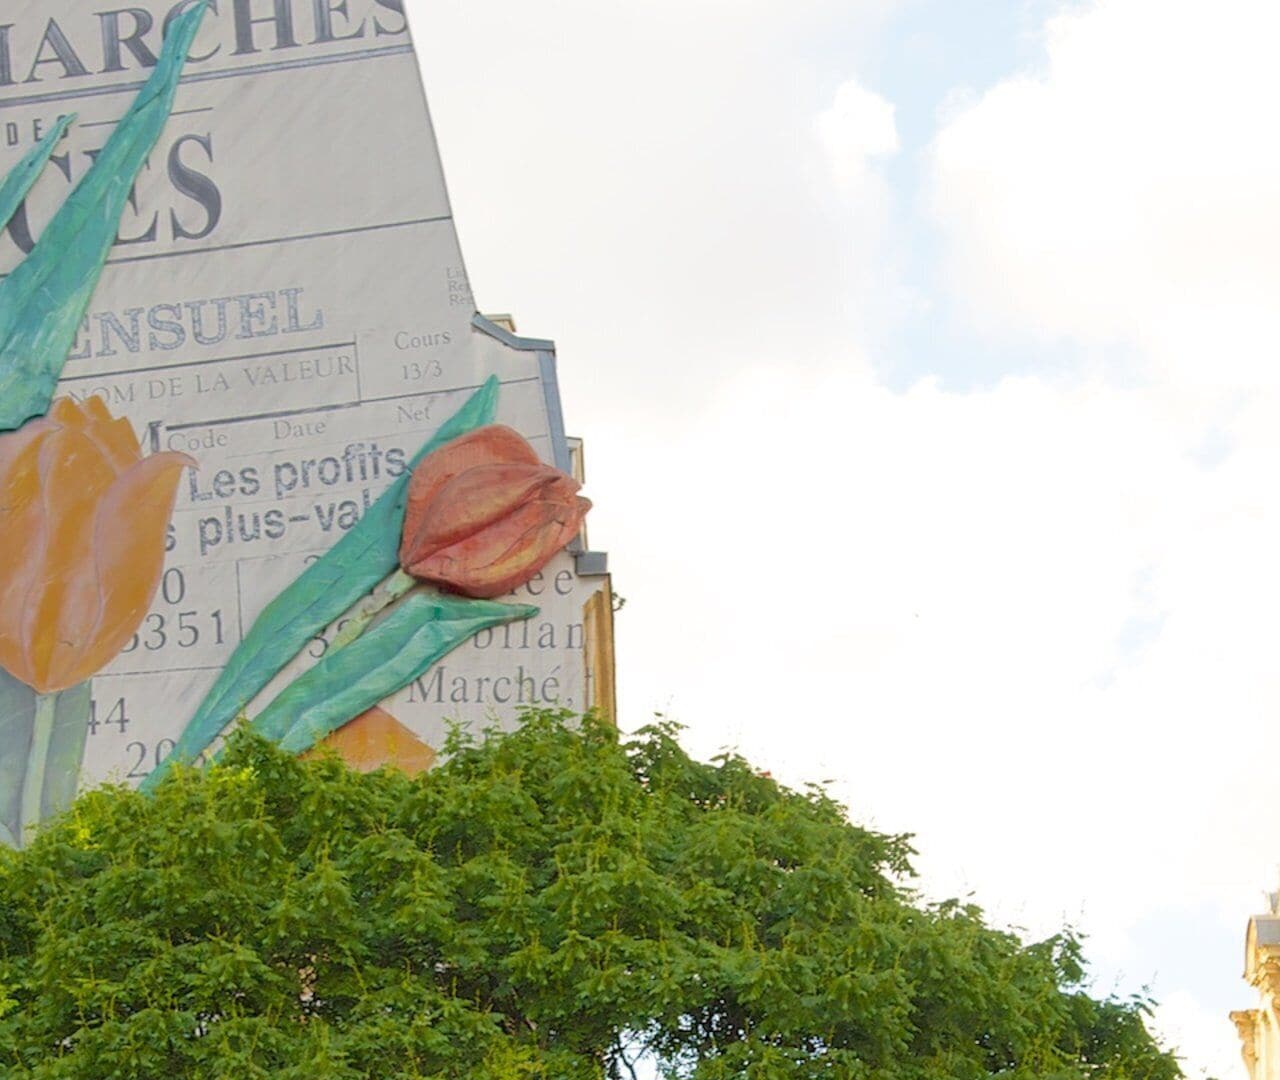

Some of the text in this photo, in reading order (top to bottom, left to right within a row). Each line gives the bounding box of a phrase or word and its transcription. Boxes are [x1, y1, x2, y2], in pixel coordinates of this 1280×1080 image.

[394, 330, 451, 351] Cours
[148, 376, 183, 400] DE
[196, 371, 231, 393] LA
[243, 354, 355, 387] VALEUR
[401, 359, 443, 381] 13/3
[166, 429, 229, 453] Code
[273, 418, 327, 441] Date
[397, 403, 431, 424] Net
[189, 443, 411, 502] Les profits
[408, 665, 573, 705] Marché.
